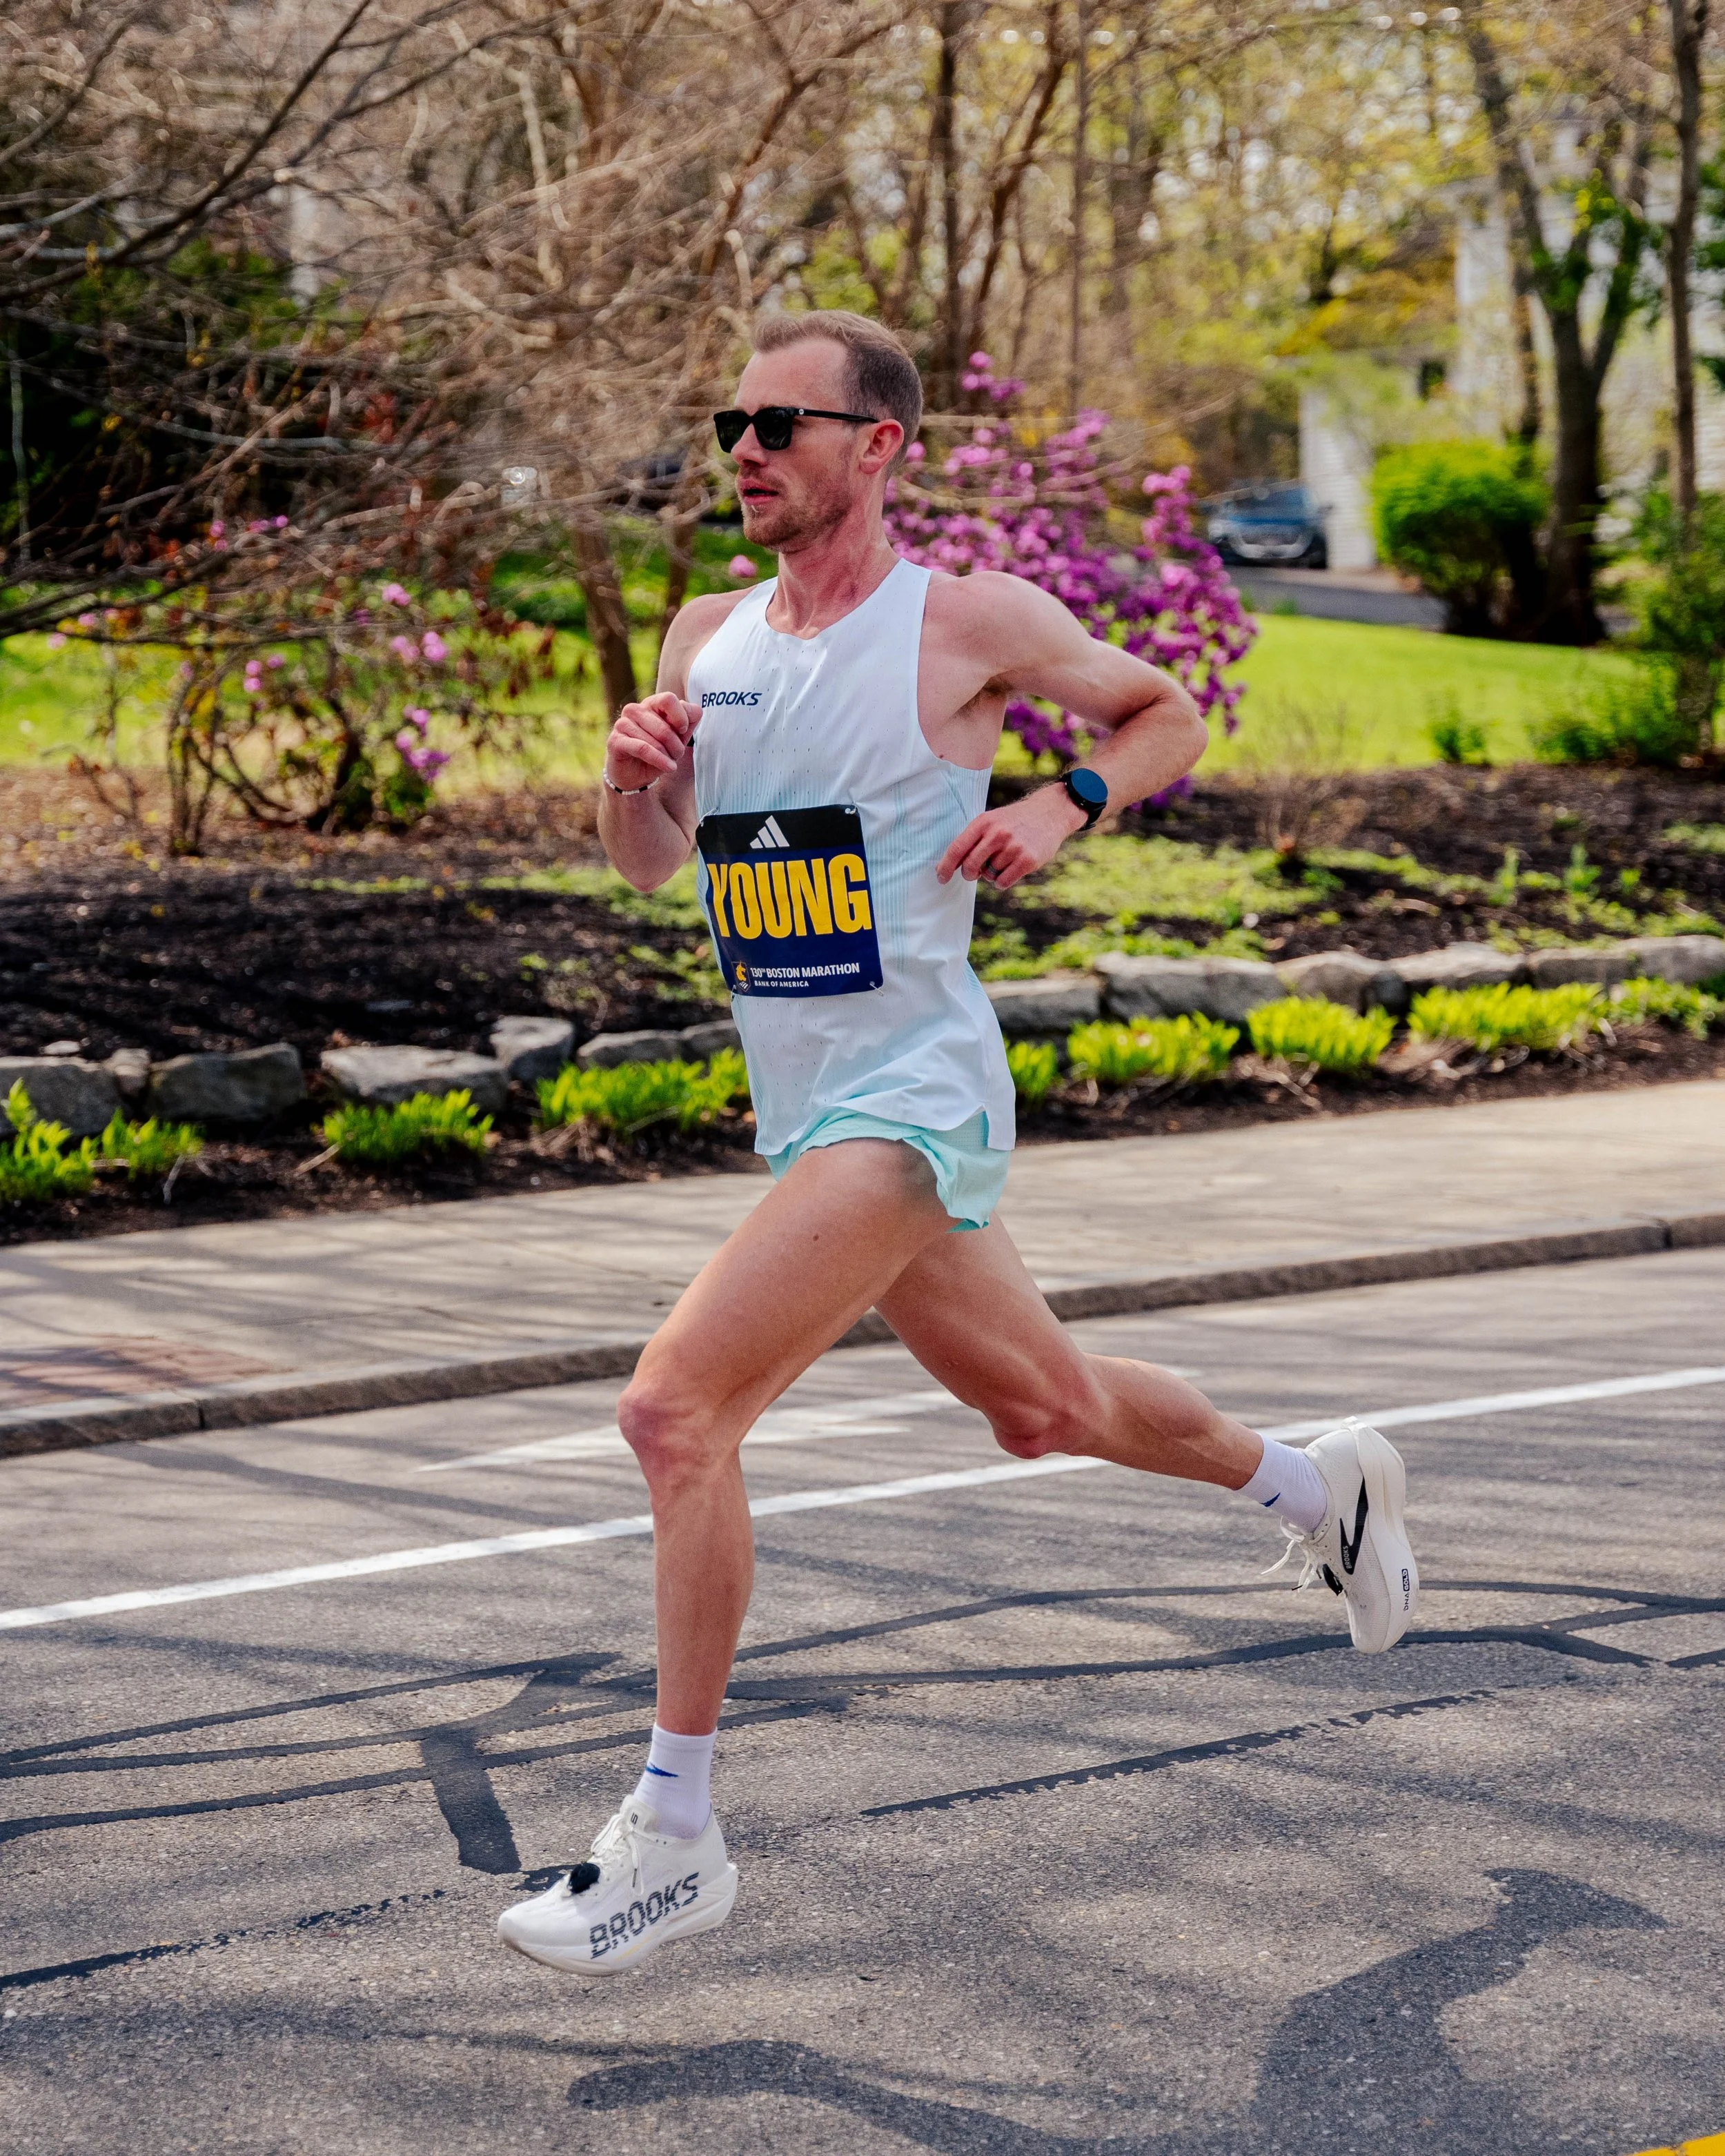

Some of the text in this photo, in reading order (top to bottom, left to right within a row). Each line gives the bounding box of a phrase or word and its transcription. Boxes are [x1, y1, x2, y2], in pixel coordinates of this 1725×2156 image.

[702, 691, 762, 708] BROOKS
[707, 853, 872, 939] YOUNG
[767, 967, 800, 978] BOSTON
[802, 962, 860, 978] MARATHON
[1343, 1545, 1352, 1569] BROOKS
[590, 1871, 700, 1959] BROOKS
